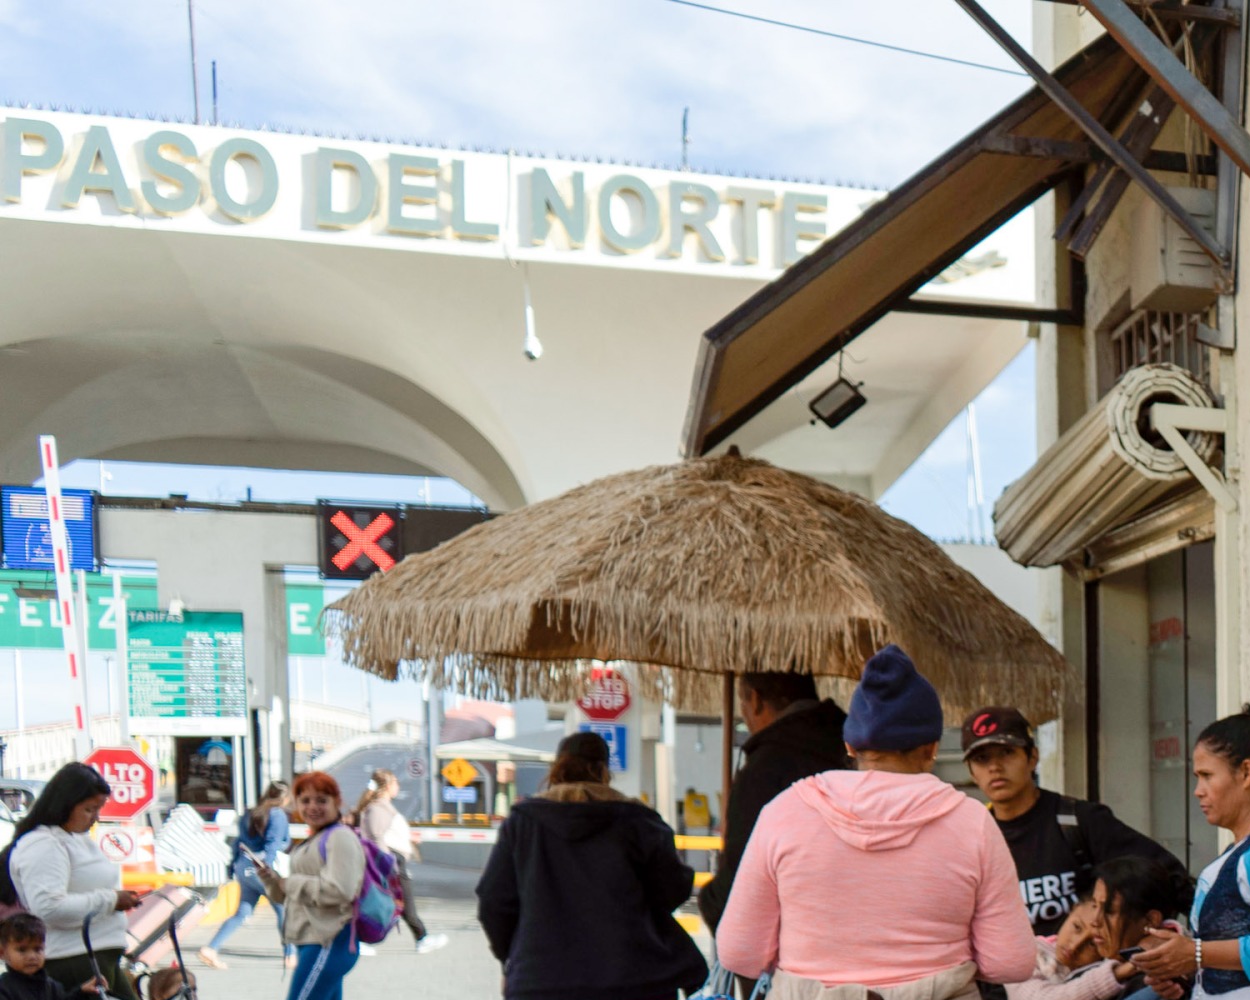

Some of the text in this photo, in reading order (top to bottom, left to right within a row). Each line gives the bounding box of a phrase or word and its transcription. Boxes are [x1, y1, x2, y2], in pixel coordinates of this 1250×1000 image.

[4, 117, 829, 267] PASO DEL NORTE
[582, 694, 625, 710] STOP
